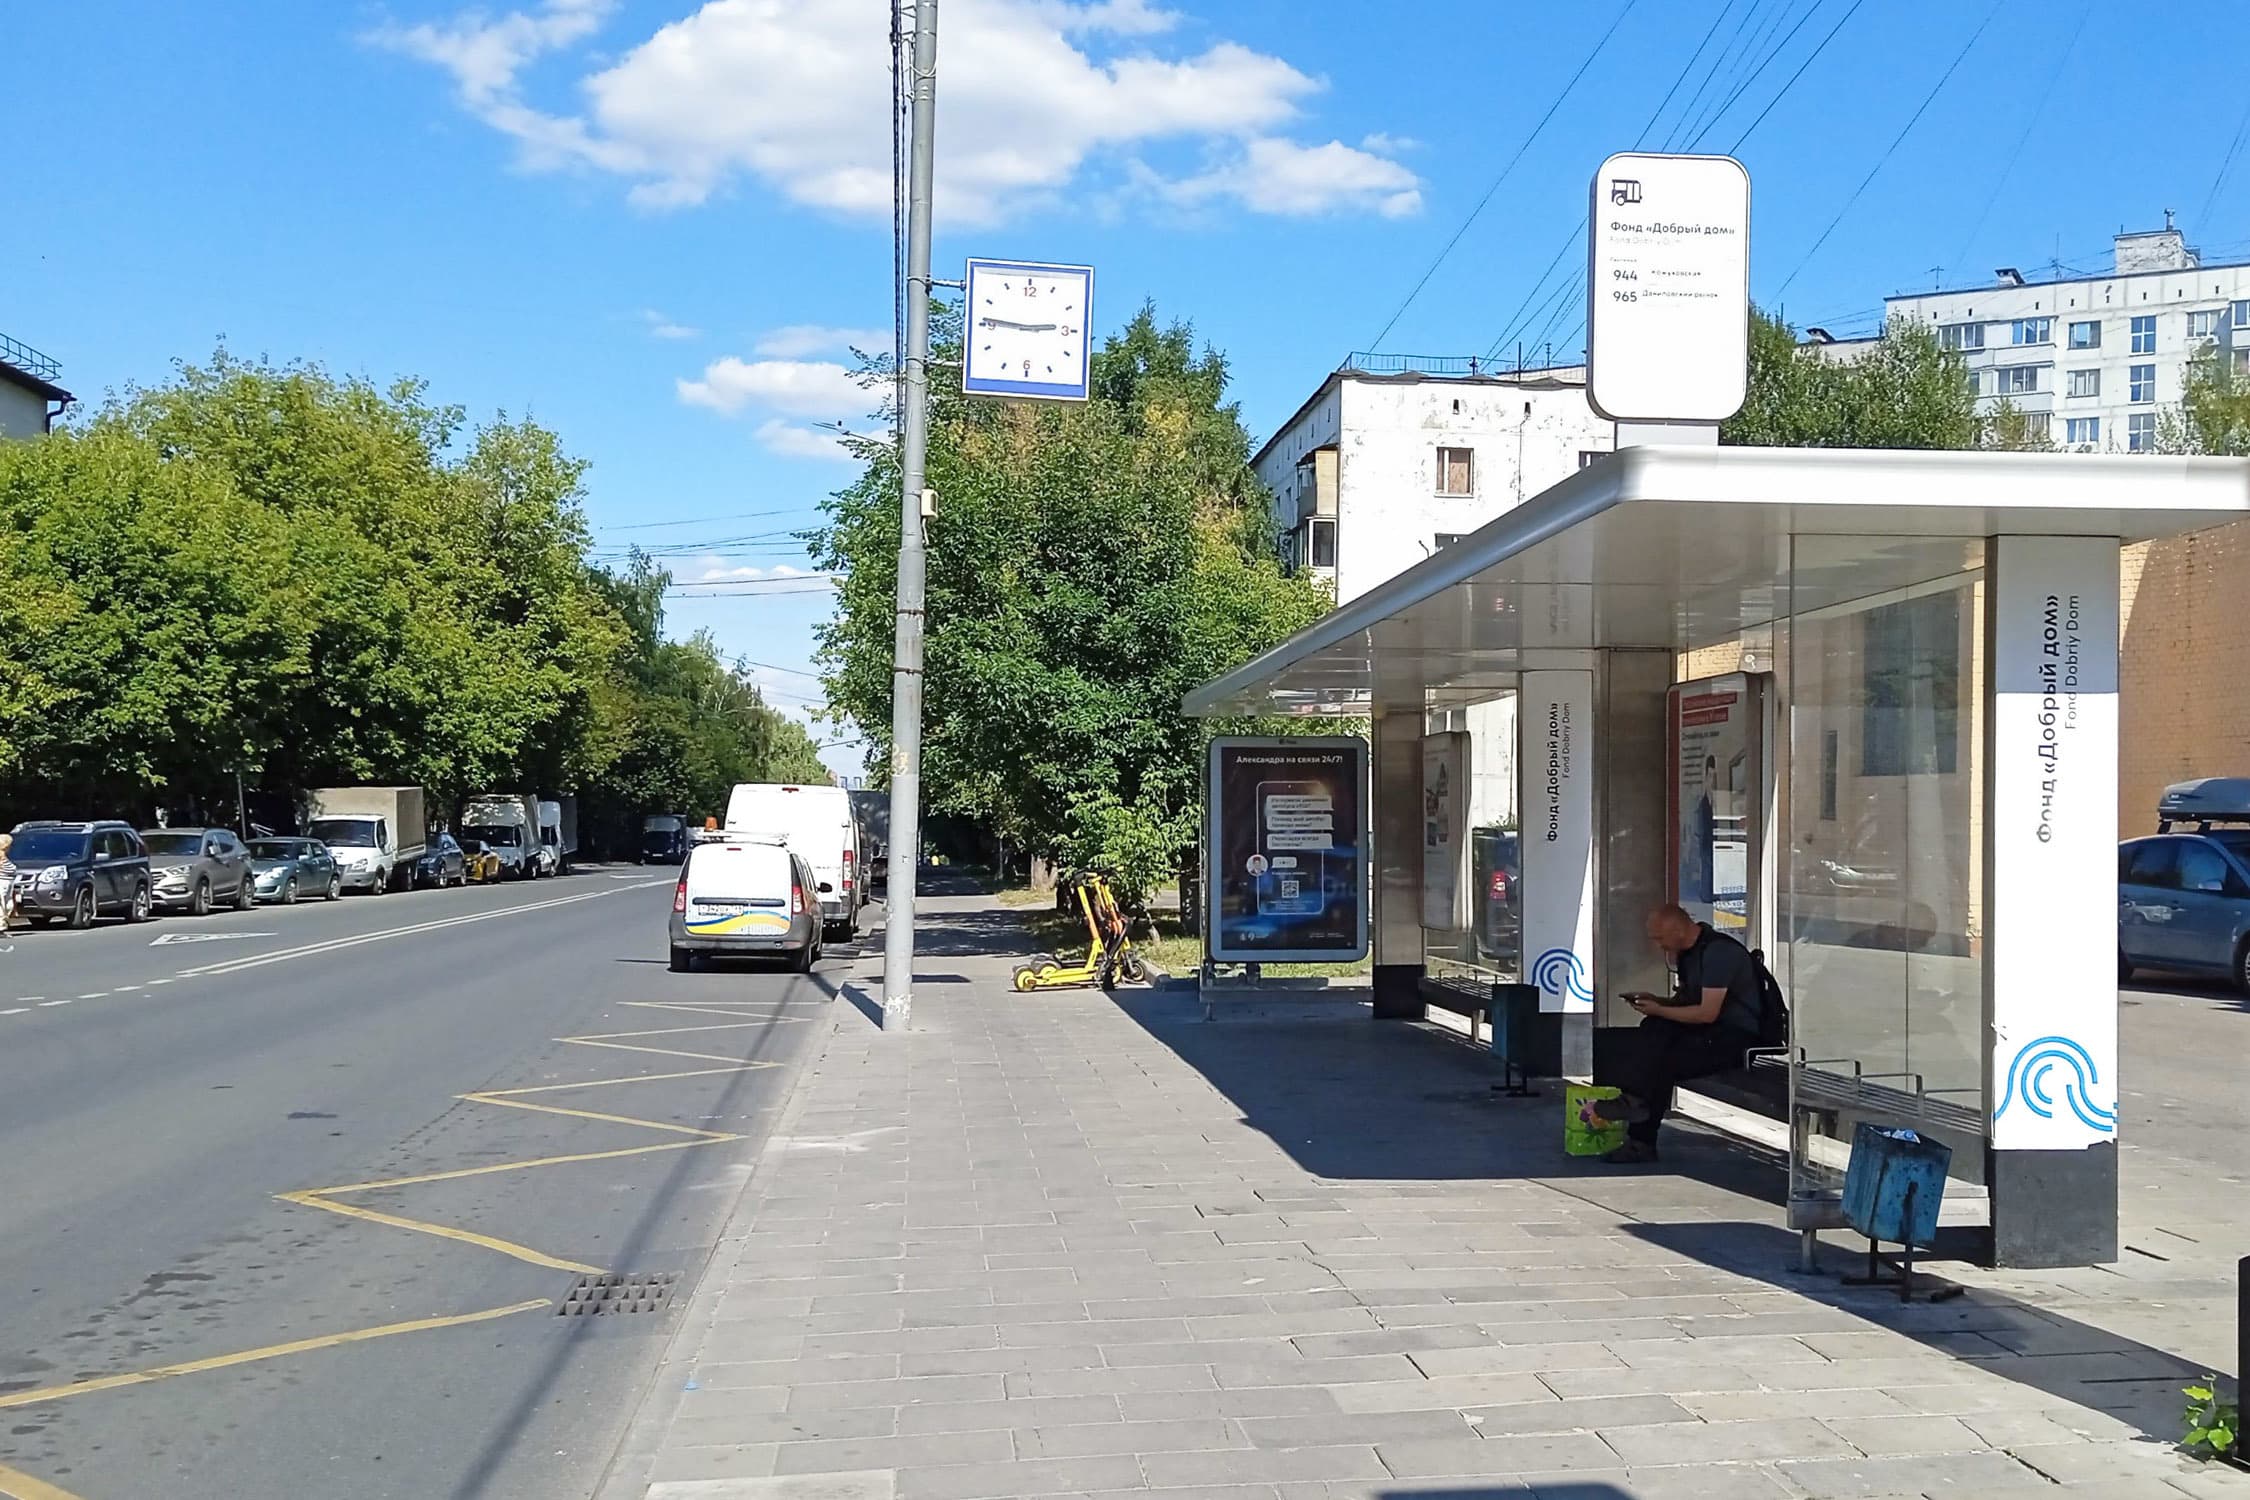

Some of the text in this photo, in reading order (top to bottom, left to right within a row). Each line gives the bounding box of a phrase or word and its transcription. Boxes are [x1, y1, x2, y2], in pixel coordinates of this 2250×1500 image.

[1610, 221, 1735, 235] Фонд «Добрый дом»
[1613, 269, 1638, 281] 944
[1024, 287, 1037, 297] 12
[1613, 291, 1638, 303] 965
[1061, 325, 1069, 336] 3
[1023, 360, 1031, 370] 6
[2065, 595, 2081, 730] Fond Dobriy Dom
[2036, 595, 2060, 843] Фонд «Добрый дом»
[1562, 703, 1571, 778] Fond Dobriy Dom
[1236, 756, 1285, 764] Александра
[1547, 703, 1560, 841] Фонд «Добрый дом»
